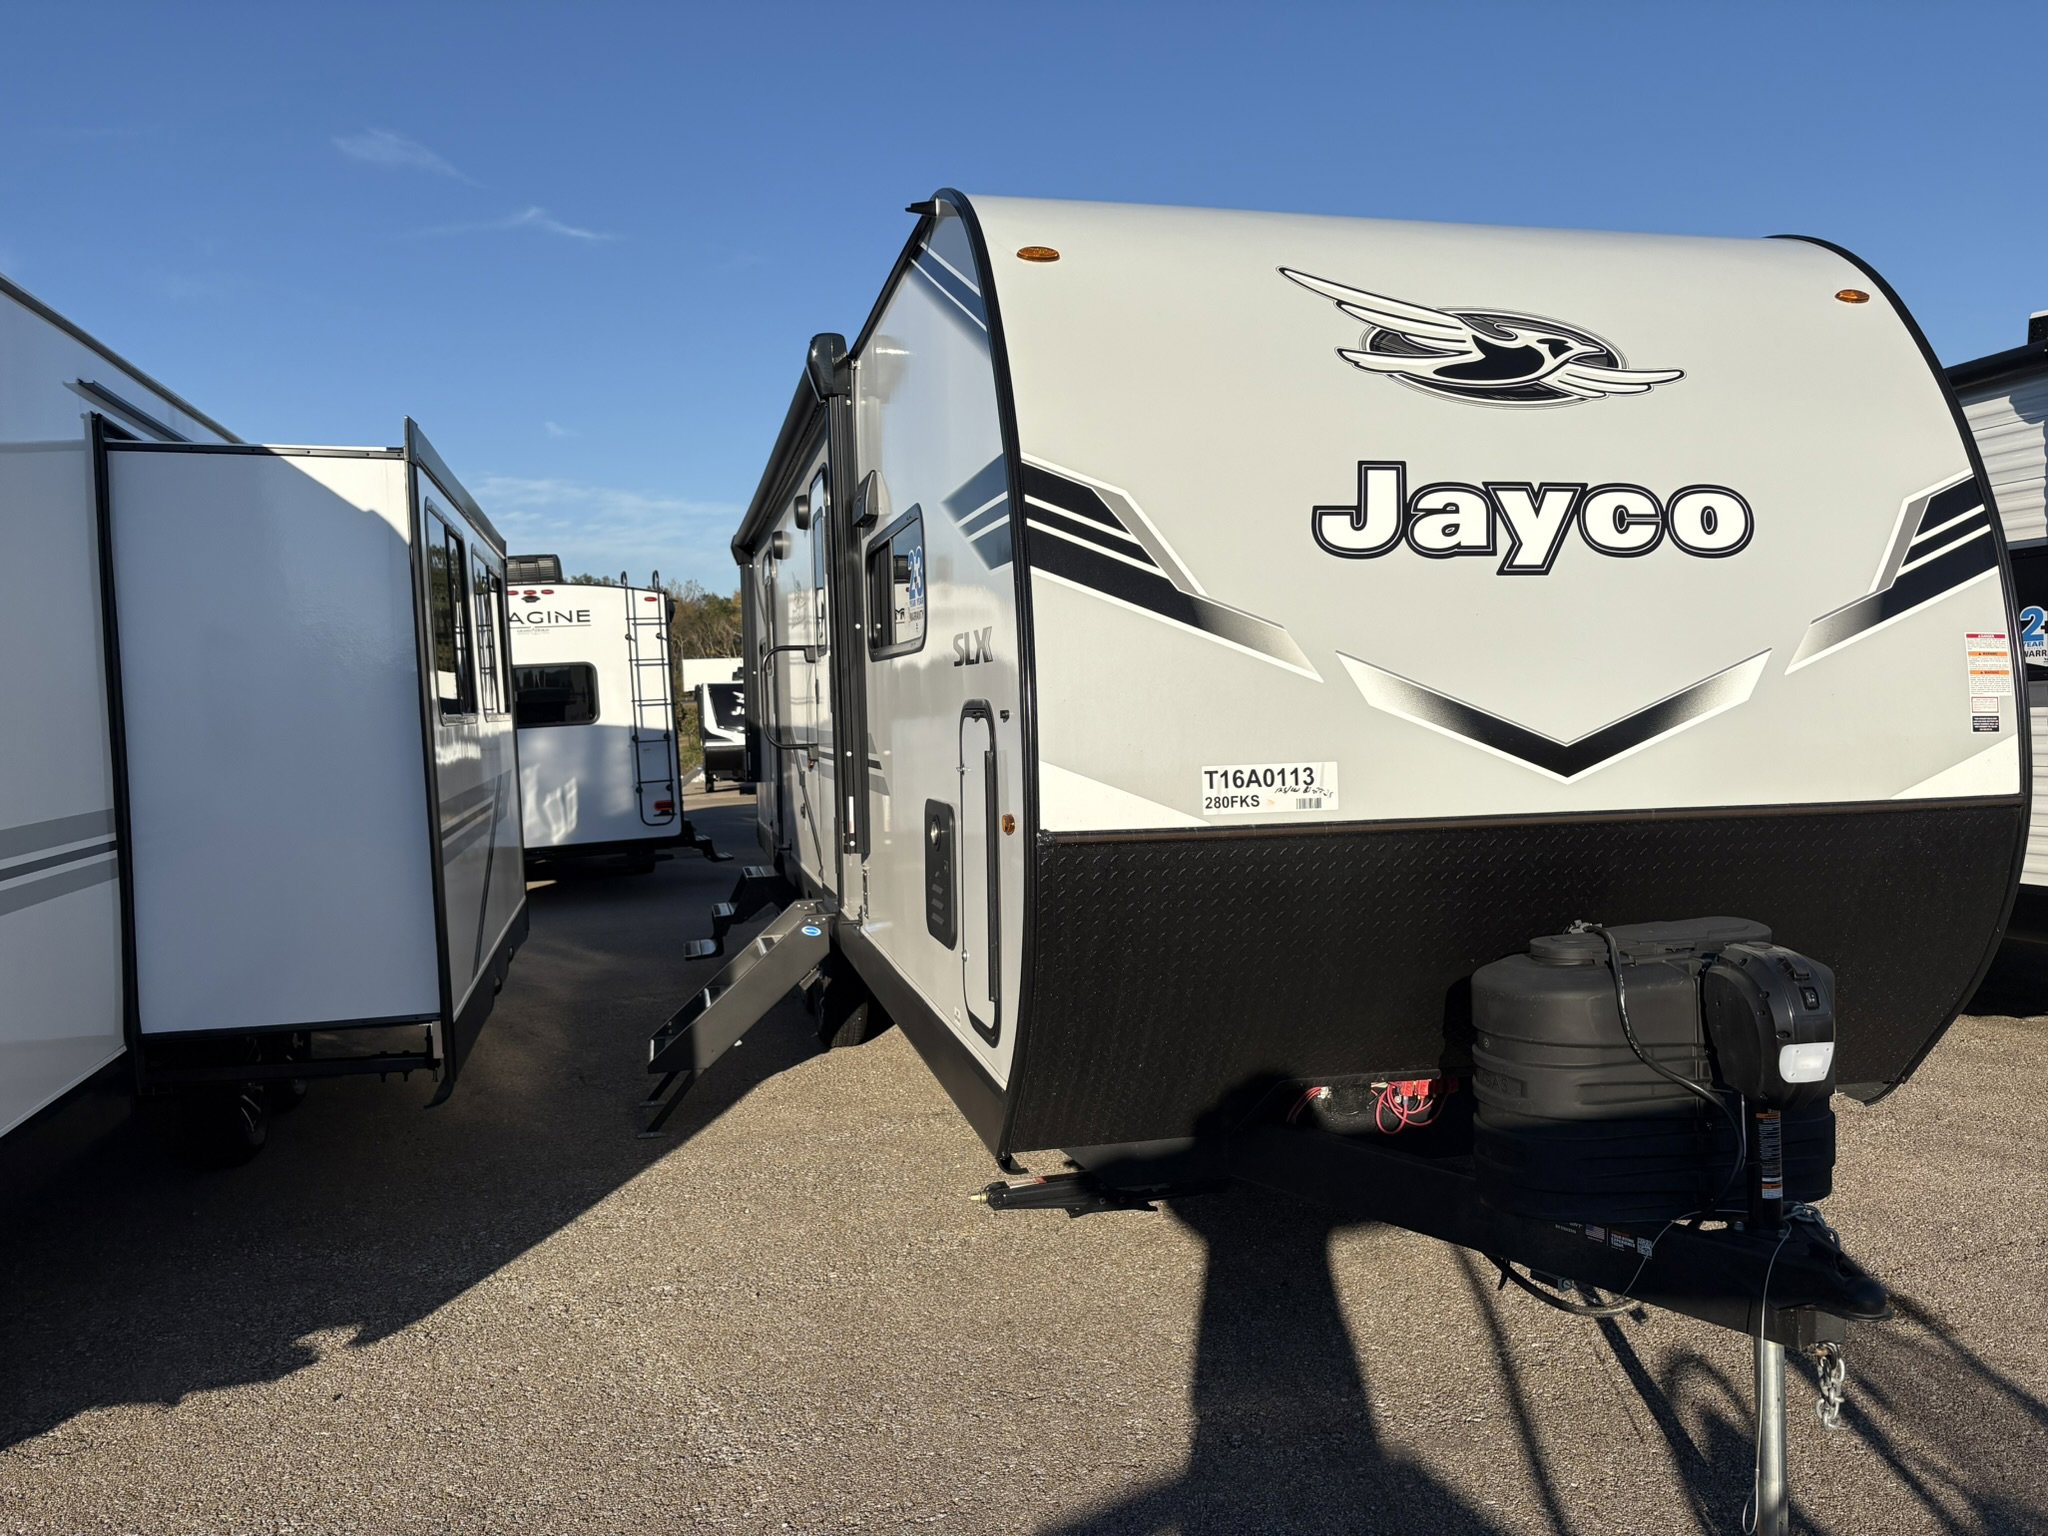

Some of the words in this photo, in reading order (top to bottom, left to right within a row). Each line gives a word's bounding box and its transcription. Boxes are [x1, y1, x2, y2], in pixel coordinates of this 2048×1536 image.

[1311, 460, 1756, 577] Jayco
[509, 609, 591, 625] AGINE
[952, 626, 994, 667] SLX
[1204, 767, 1315, 790] T16A0113
[1204, 795, 1260, 809] 280FKS
